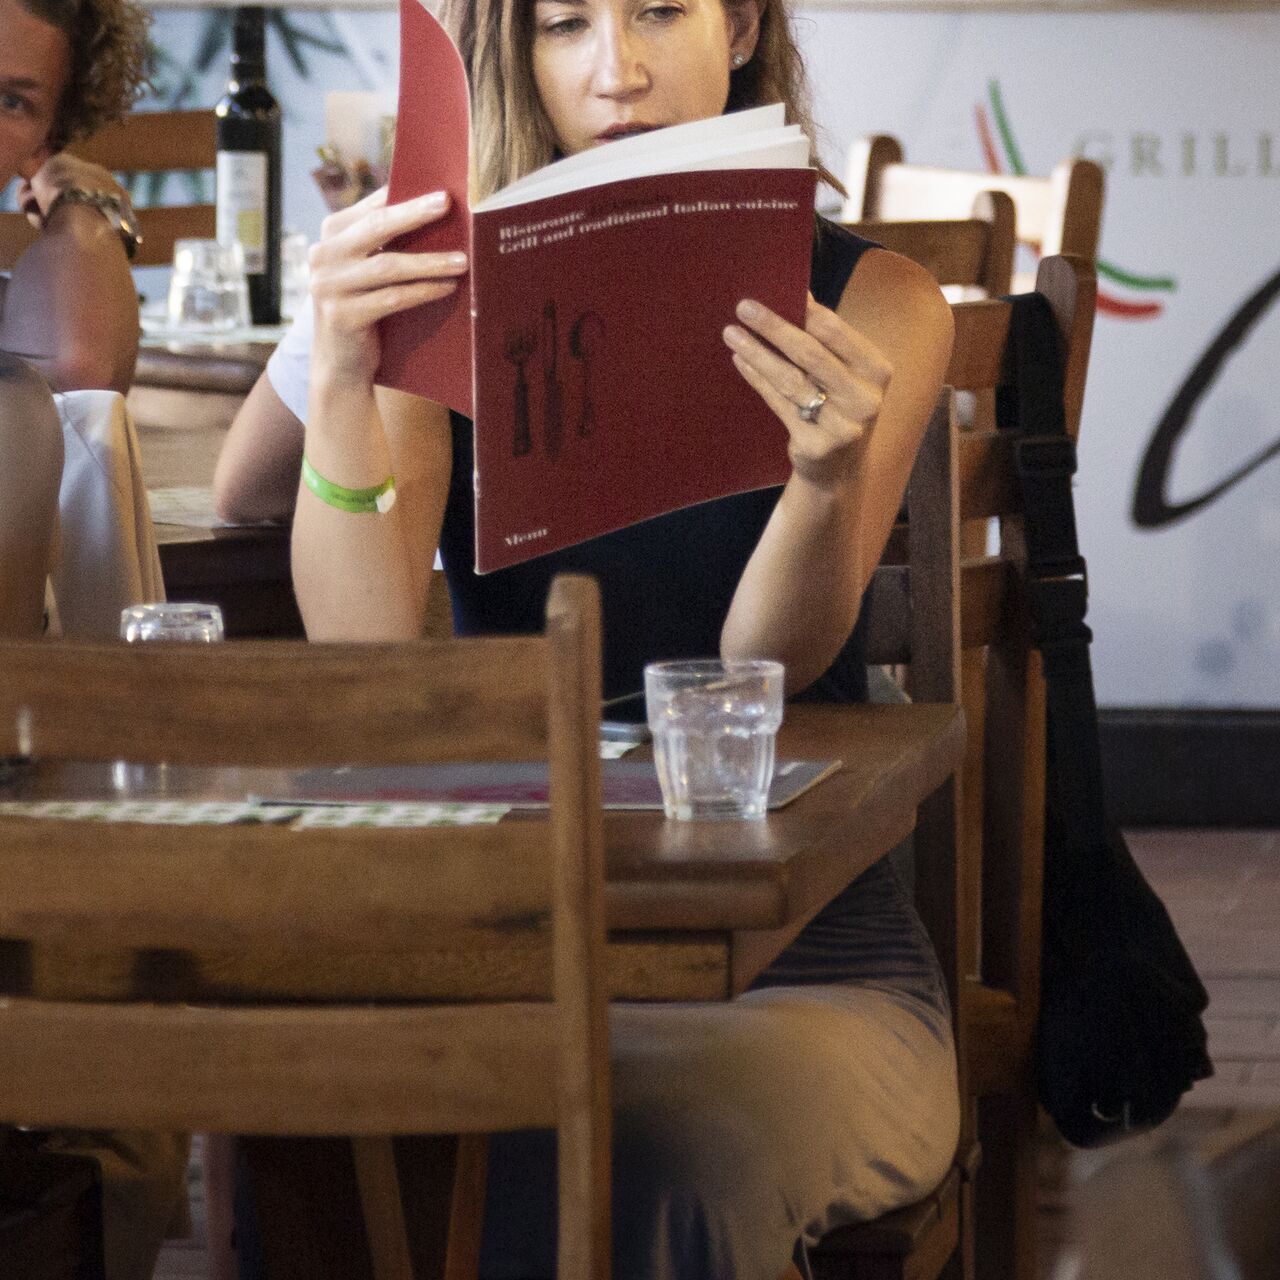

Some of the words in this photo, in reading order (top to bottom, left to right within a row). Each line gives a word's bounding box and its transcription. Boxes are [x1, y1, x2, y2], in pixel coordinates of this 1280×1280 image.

[499, 235, 538, 254] Grill
[543, 224, 574, 243] and
[579, 204, 668, 234] traditional
[674, 200, 731, 214] Italian
[736, 198, 799, 210] cuisine
